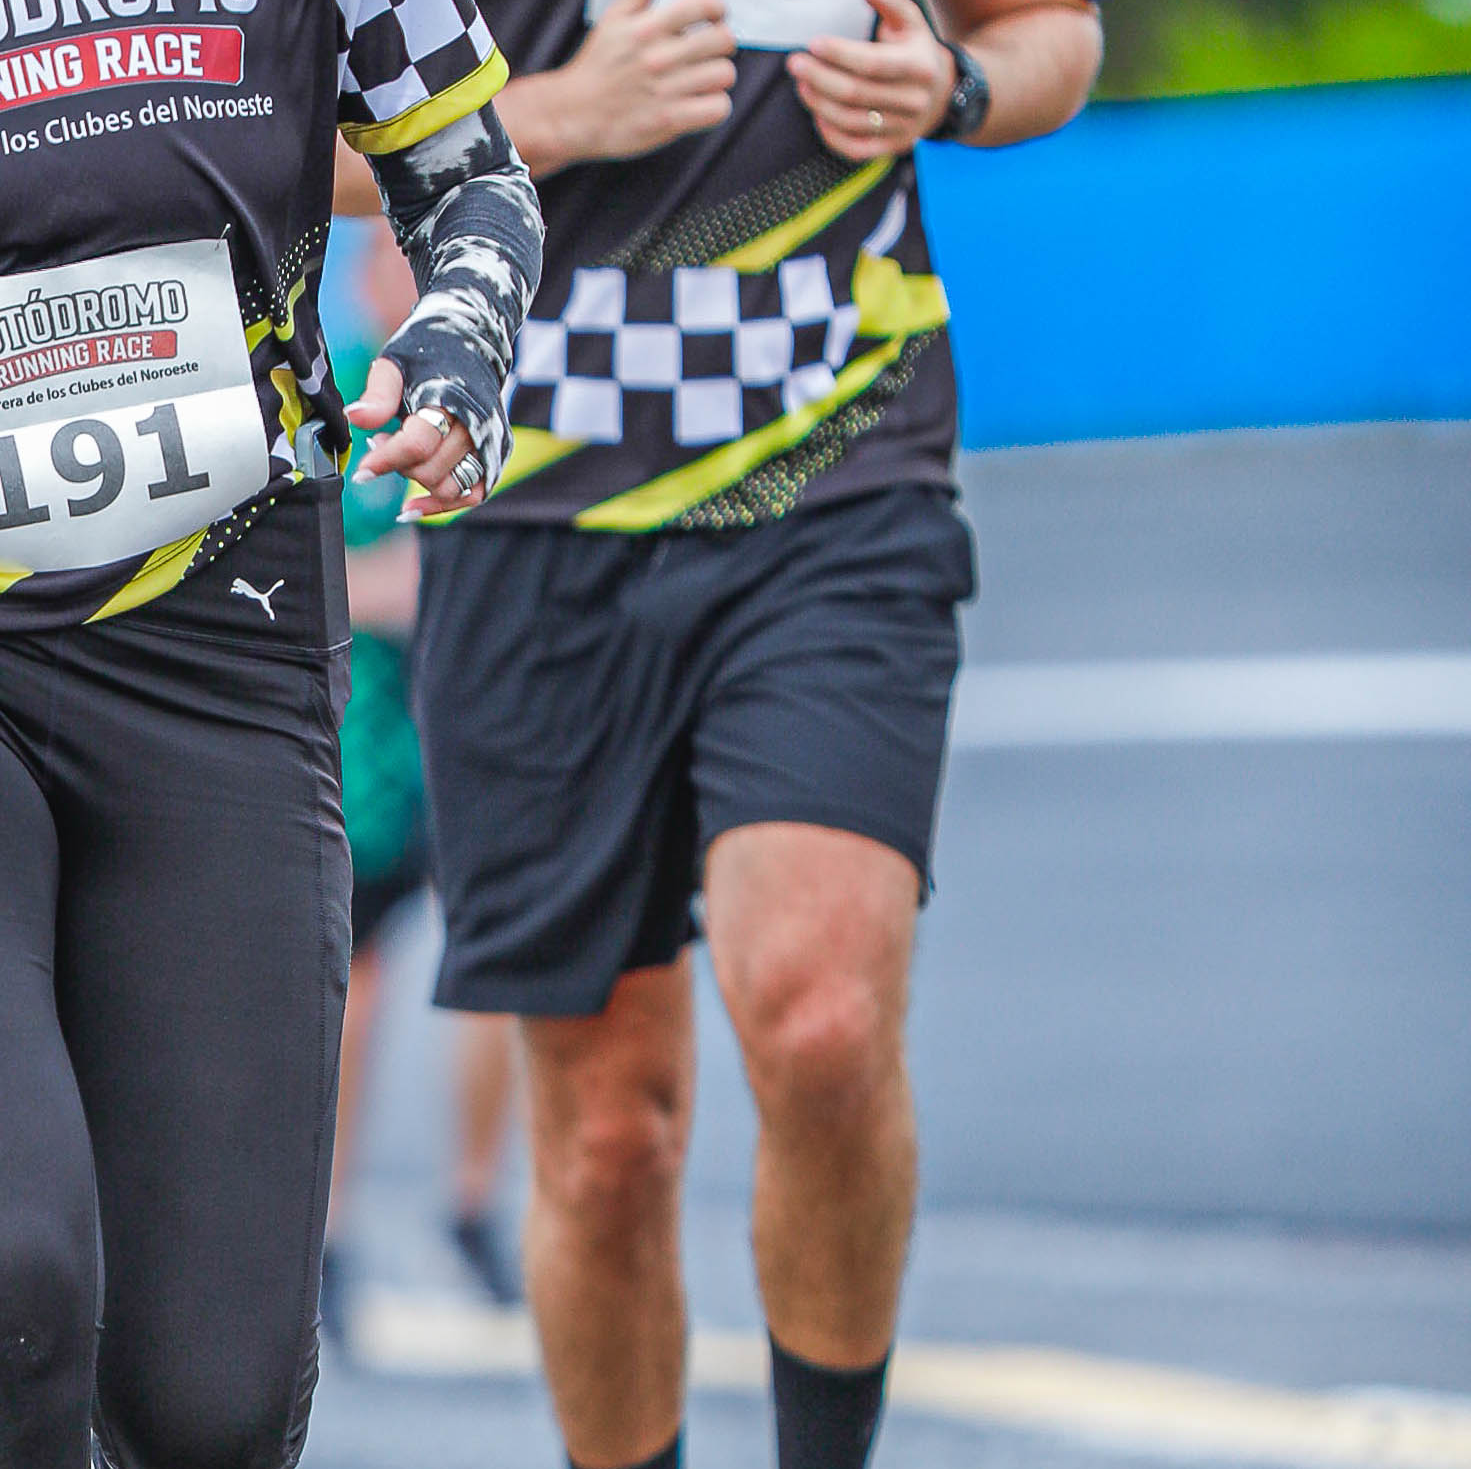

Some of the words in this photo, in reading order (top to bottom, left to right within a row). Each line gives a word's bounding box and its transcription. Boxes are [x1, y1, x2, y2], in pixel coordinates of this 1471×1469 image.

[94, 34, 204, 81] RACE
[1, 129, 39, 156] los
[44, 110, 133, 147] Clubes
[138, 96, 179, 125] del
[185, 93, 274, 120] Noroeste
[97, 336, 153, 362] RACE
[27, 390, 44, 405] de
[47, 386, 67, 401] los
[69, 377, 114, 397] Clubes
[117, 371, 138, 386] del
[141, 361, 199, 383] Noroeste
